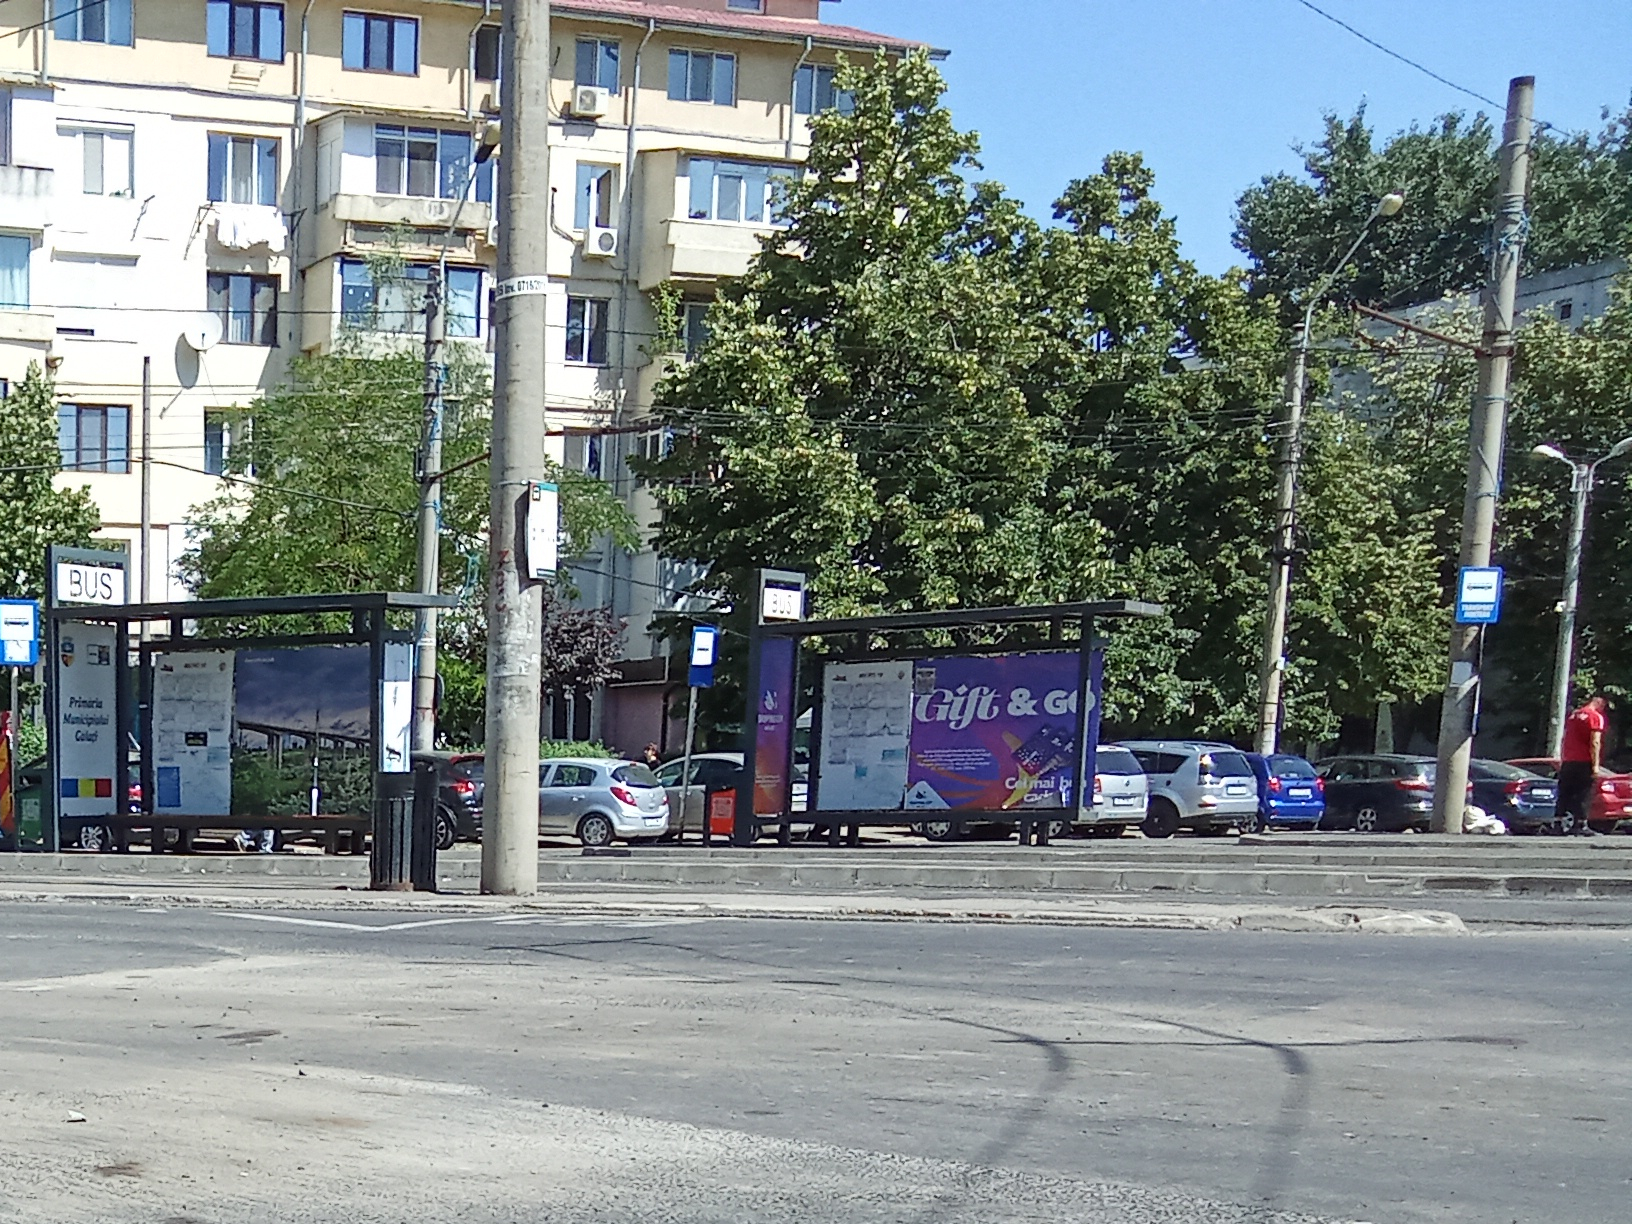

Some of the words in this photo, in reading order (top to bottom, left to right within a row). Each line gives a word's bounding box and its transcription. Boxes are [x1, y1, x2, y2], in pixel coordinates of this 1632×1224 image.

[69, 569, 113, 601] BUS
[915, 683, 1002, 731] Gift
[1006, 687, 1039, 717] &
